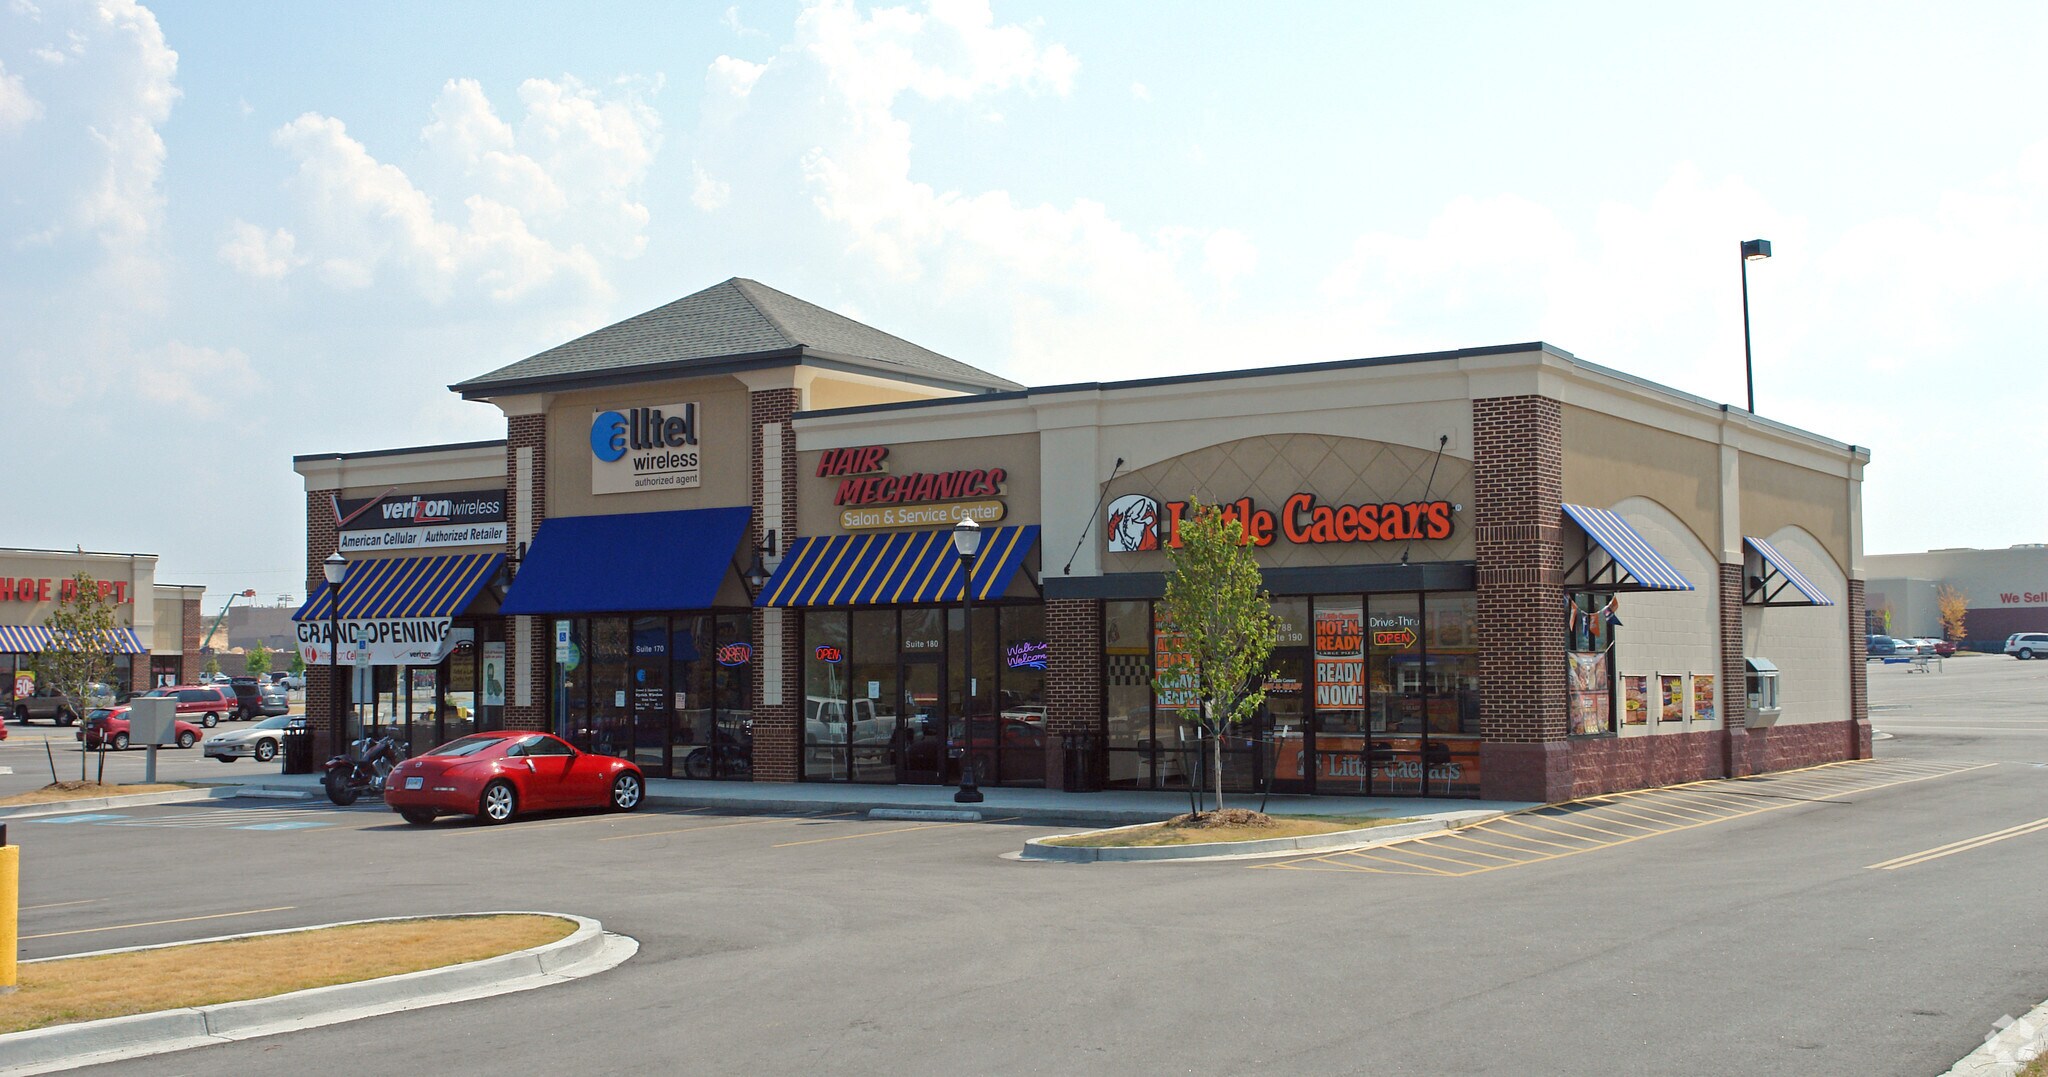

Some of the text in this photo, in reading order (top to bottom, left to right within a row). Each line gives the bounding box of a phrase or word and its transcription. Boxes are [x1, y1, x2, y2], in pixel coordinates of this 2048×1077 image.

[633, 451, 697, 471] wireless
[816, 446, 889, 478] HAIR
[634, 474, 698, 487] authorized agent
[833, 467, 1007, 506] MECHANICS
[844, 504, 998, 526] Salon & Service Center
[1282, 492, 1453, 544] Caesars
[342, 527, 502, 548] American Cellular Authorized Retailer
[61, 579, 135, 604] DPT.
[2000, 592, 2020, 604] We
[297, 620, 449, 644] GRAND OPENING
[1370, 616, 1420, 628] Drive-Thru
[1288, 632, 1302, 642] 190
[1316, 636, 1363, 651] READY
[1377, 632, 1410, 644] OPEN
[718, 646, 750, 663] OPEN
[816, 648, 840, 661] OPEN
[1317, 662, 1363, 682] READY
[1317, 684, 1363, 706] NOW!
